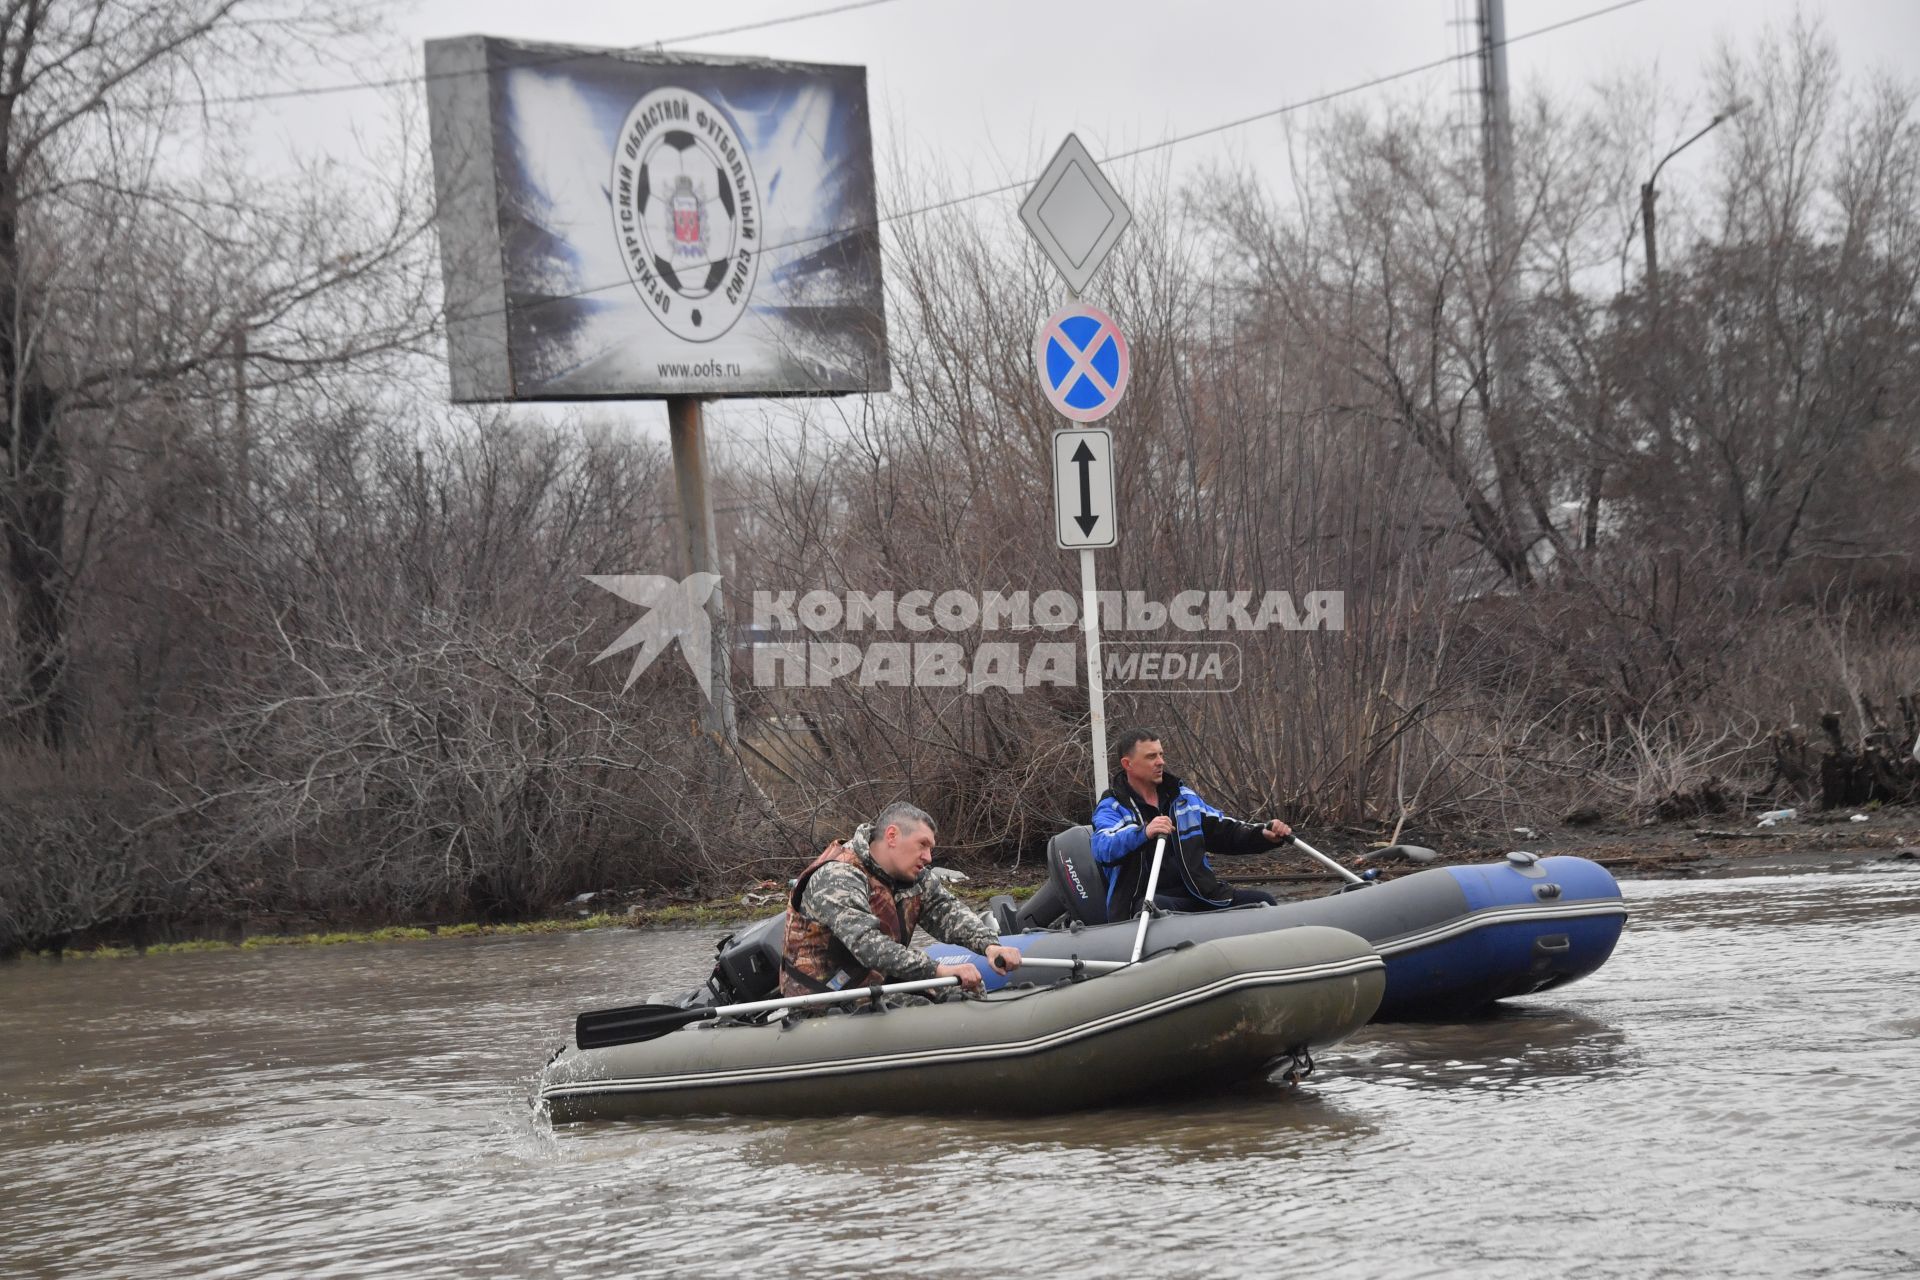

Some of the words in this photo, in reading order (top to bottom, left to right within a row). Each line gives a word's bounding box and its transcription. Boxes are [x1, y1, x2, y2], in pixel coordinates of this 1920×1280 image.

[625, 97, 689, 160] ОБЛАСТНОЙ
[696, 110, 756, 240] ФУТБОЛЬНЫЙ
[619, 164, 670, 314] ОРЕНБУРГСКИЙ
[726, 248, 751, 305] СОЮЗ
[657, 359, 740, 377] www.oofs.ru
[1064, 857, 1089, 900] TARPON
